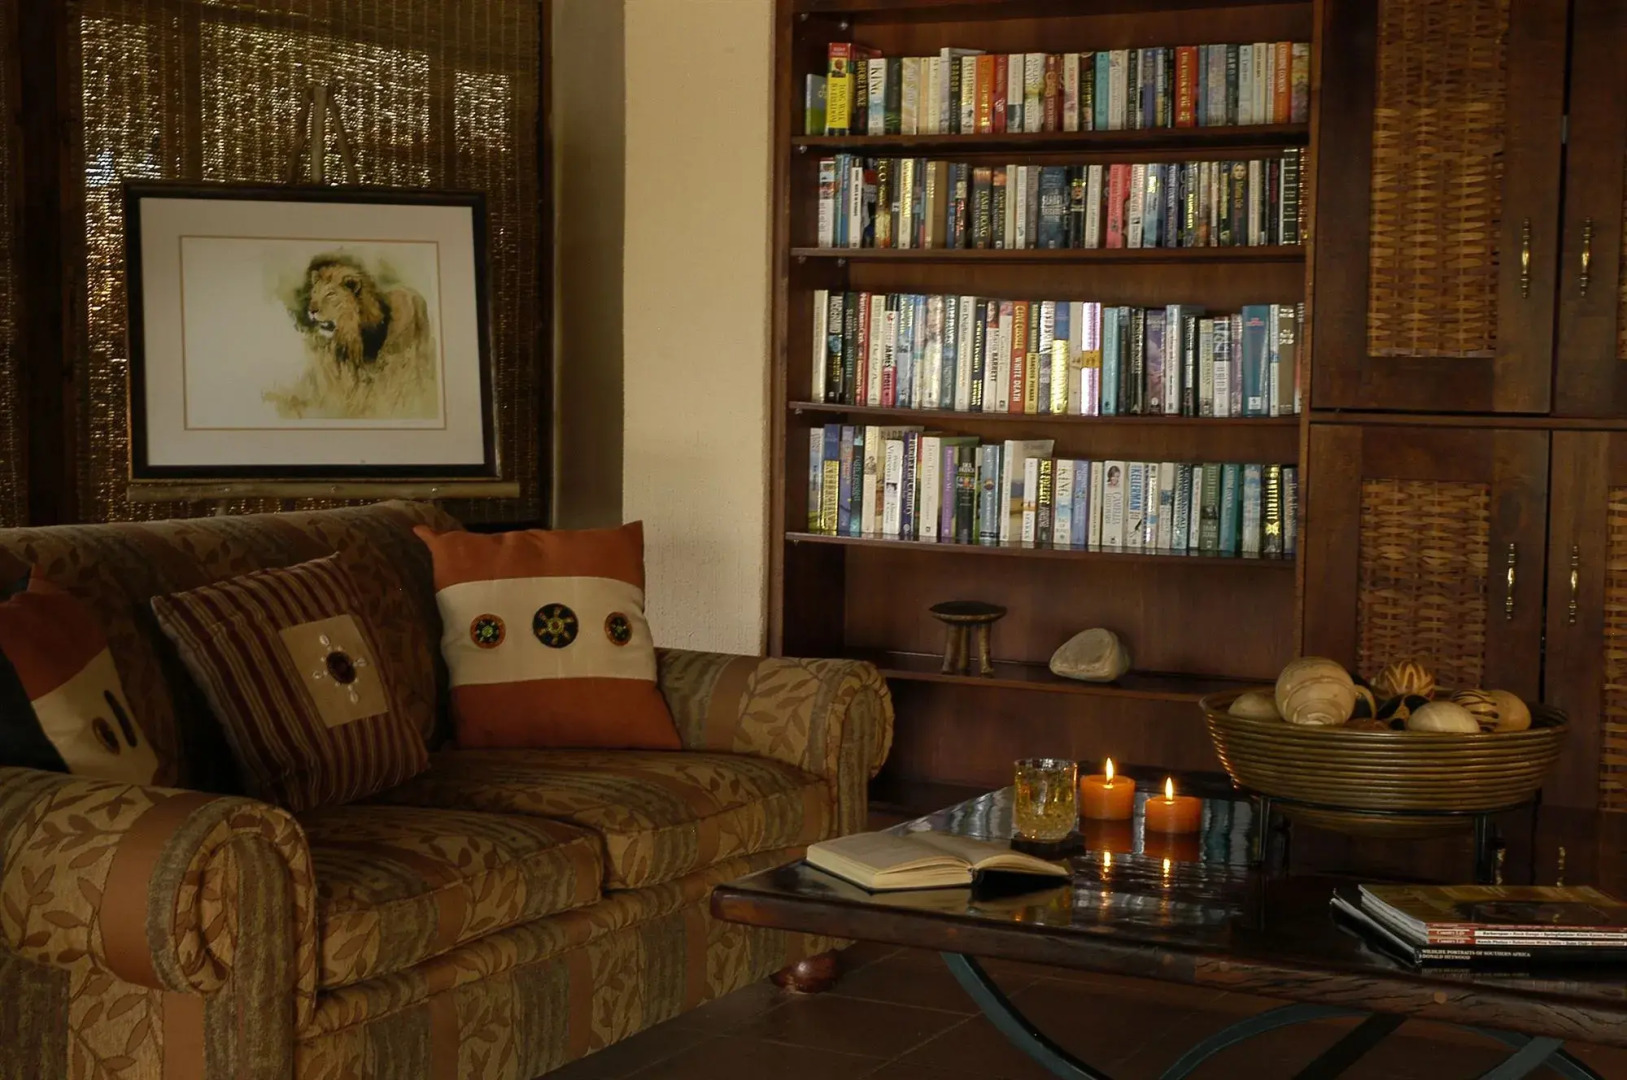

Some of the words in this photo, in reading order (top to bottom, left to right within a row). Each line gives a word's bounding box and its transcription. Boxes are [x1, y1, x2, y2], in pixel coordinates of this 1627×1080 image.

[871, 67, 883, 95] KING
[1015, 306, 1025, 324] CLIVE
[1014, 324, 1024, 349] CUSSLER
[885, 345, 895, 368] JAMES
[1014, 357, 1022, 378] WHITE
[1013, 380, 1022, 402] DEATH
[853, 474, 861, 502] rendell
[1058, 468, 1070, 497] KING
[1130, 469, 1142, 510] KELLERMAN
[906, 482, 915, 515] Country
[1112, 492, 1122, 525] CAMELLIA
